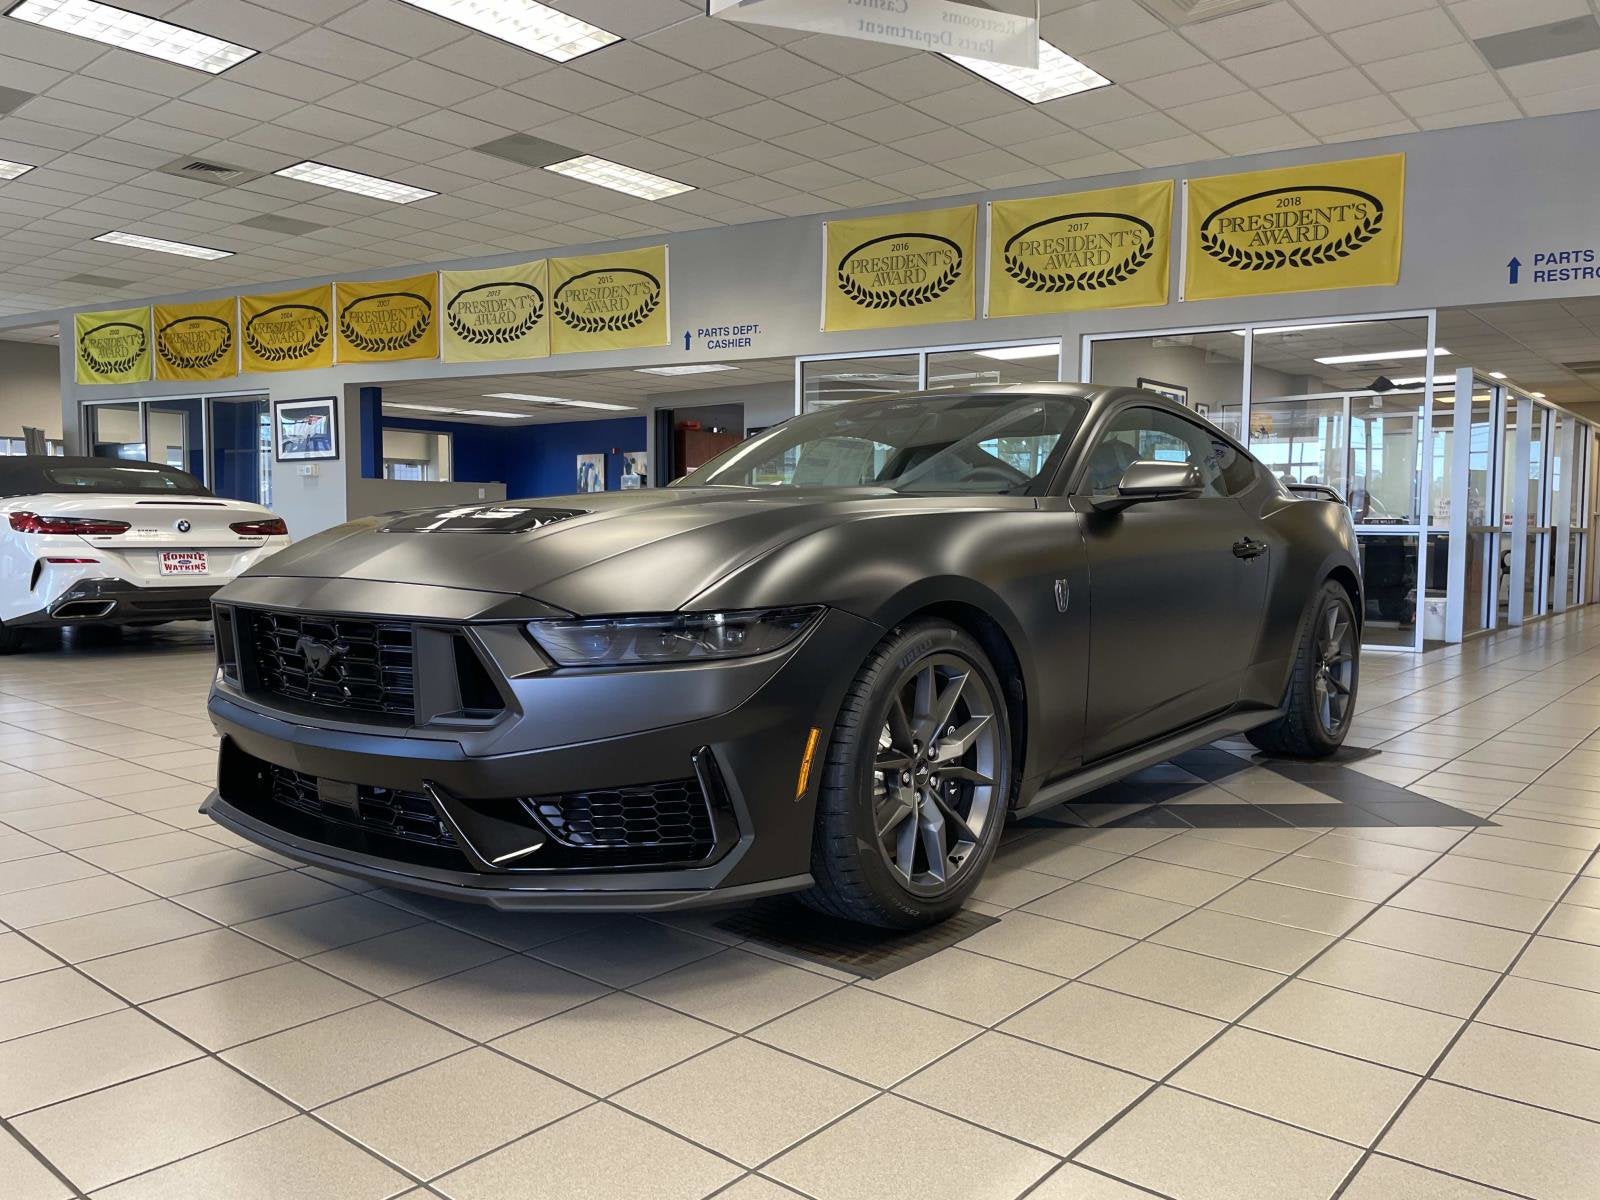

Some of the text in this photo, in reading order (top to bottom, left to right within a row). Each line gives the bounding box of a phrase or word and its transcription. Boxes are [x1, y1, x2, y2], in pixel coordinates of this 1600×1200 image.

[1276, 197, 1302, 208] 2018
[1217, 203, 1367, 235] PRESIDENT'S
[1068, 222, 1090, 233] 2017
[1248, 224, 1330, 247] AWARD
[891, 243, 910, 252] 2016
[1018, 229, 1142, 257] PRESIDENT'S
[850, 250, 953, 275] PRESIDENT'S
[1045, 249, 1111, 271] AWARD
[1534, 250, 1595, 266] PARTS
[597, 275, 614, 285] 2015
[871, 267, 928, 288] AWARD
[563, 281, 651, 303] PRESIDENT'S
[456, 294, 536, 315] PRESIDENT'S
[583, 297, 630, 314] AWARD
[349, 303, 423, 324] PRESIDENT'S
[474, 311, 517, 326] AWARD
[254, 314, 320, 334] PRESIDENT'S
[365, 318, 407, 335] AWARD
[698, 324, 761, 338] PARTS DEPT.
[267, 330, 306, 345] AWARD
[707, 337, 751, 349] CASHIER
[98, 346, 129, 359] AWARD
[180, 341, 211, 354] AWARD
[163, 552, 205, 562] RONNIE
[164, 562, 206, 571] WATKINS
